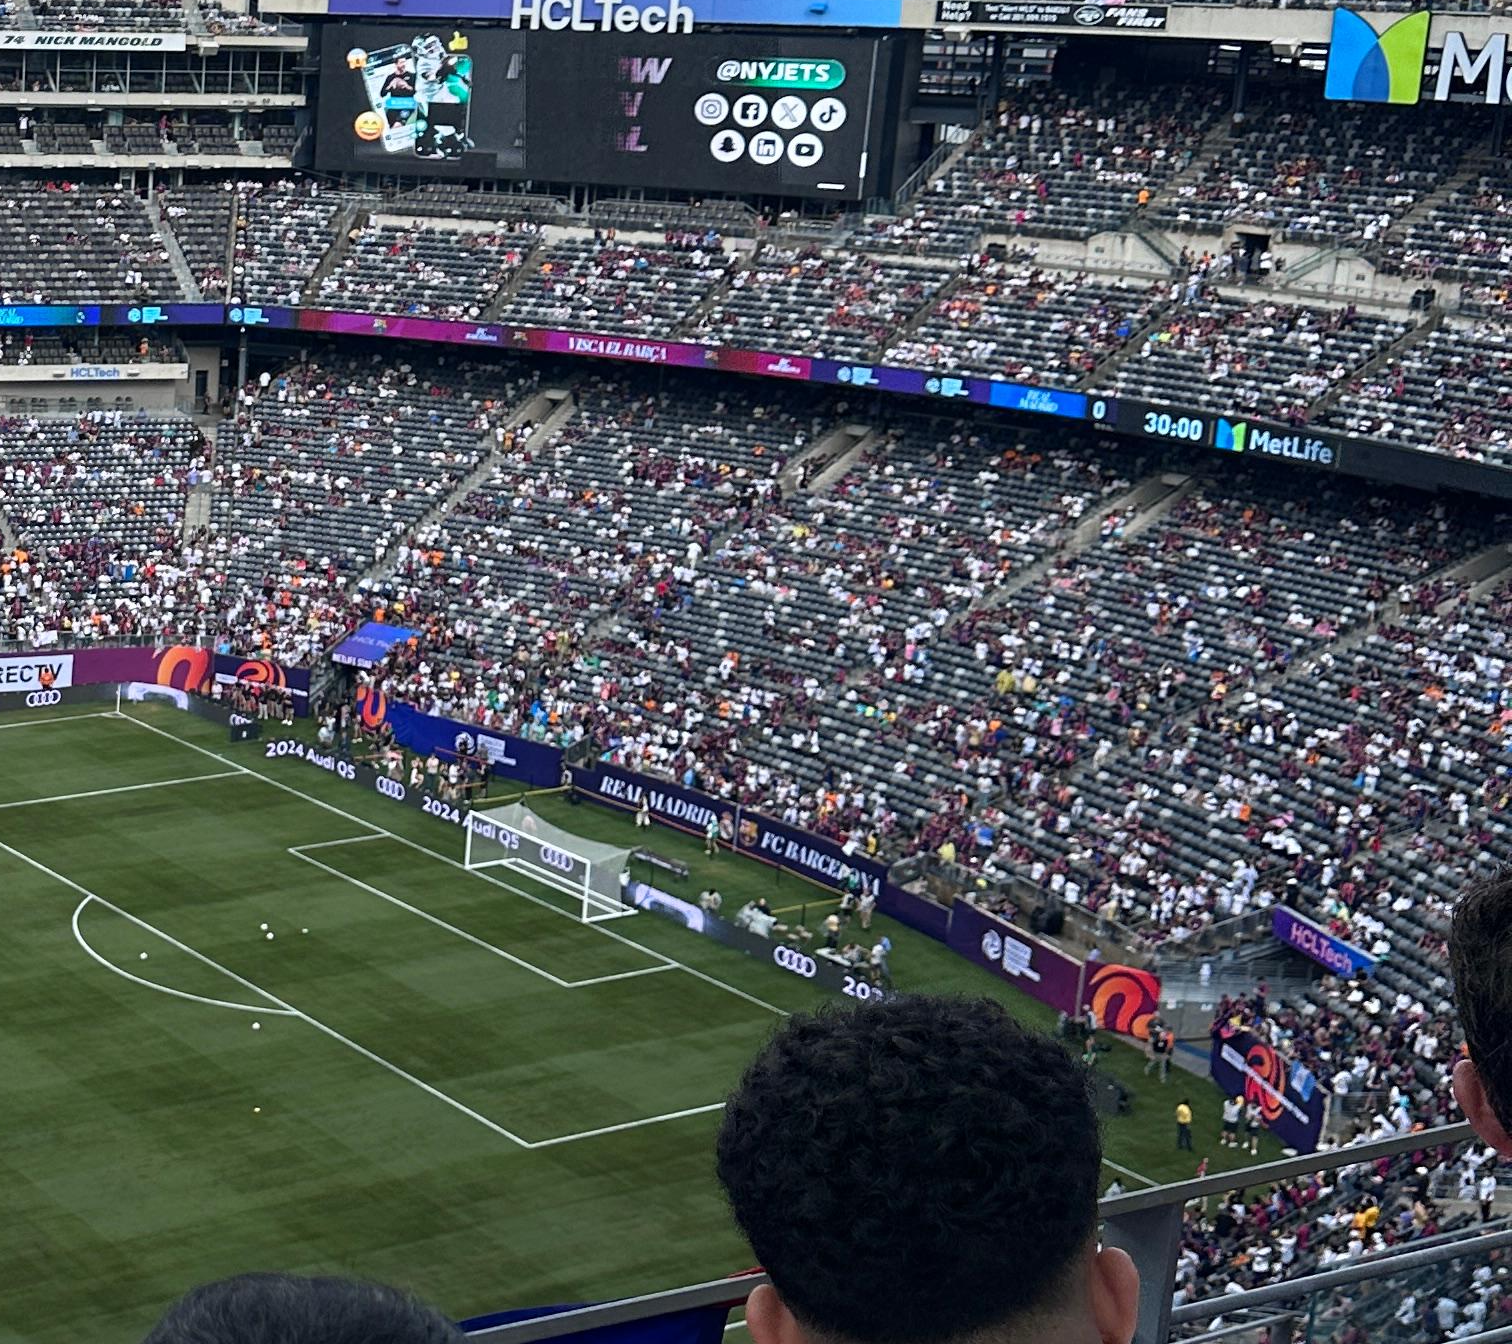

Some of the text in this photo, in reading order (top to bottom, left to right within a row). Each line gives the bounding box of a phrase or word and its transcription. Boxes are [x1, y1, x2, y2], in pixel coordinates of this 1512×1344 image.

[1105, 8, 1148, 17] FANS
[1117, 17, 1165, 27] FIRST
[3, 35, 163, 46] 74 NICK MANGOLD
[717, 59, 832, 83] @NYJETS
[1433, 30, 1512, 105] M
[569, 337, 667, 362] VISCA EL BARÇA
[70, 367, 121, 378] HCLTech
[1143, 412, 1204, 442] 30:00
[1249, 429, 1334, 465] MetLife
[265, 739, 356, 780] 2024 Audi Q5
[600, 775, 715, 827] REAL MADRID
[422, 795, 520, 850] 2024 Audi Q5
[760, 831, 785, 855] FC
[1290, 921, 1353, 974] HCLTech
